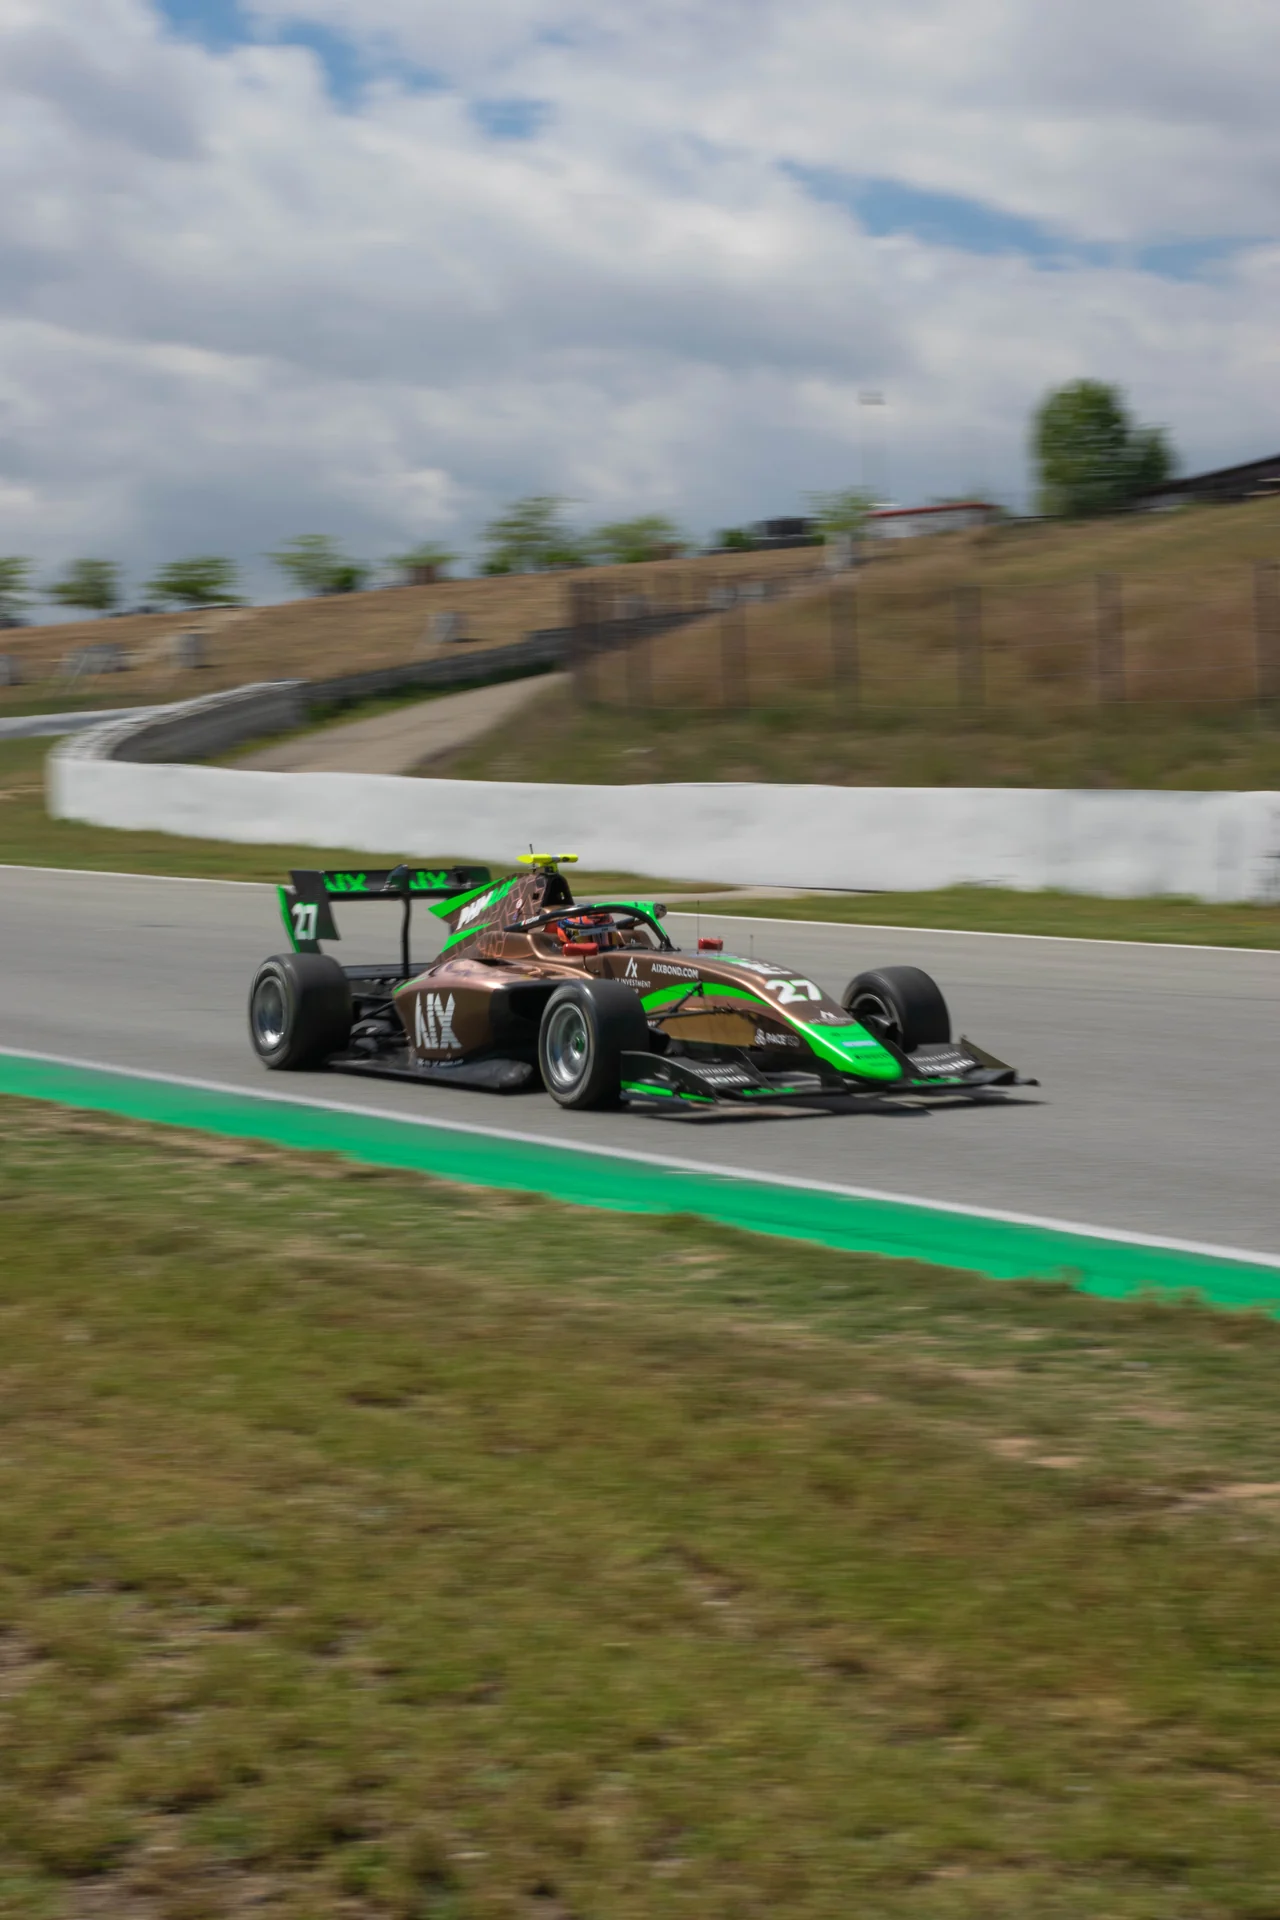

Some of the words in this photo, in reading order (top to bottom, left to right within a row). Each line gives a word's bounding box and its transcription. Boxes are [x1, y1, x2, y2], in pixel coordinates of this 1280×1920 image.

[291, 903, 318, 940] 27
[652, 963, 699, 979] AIXBOND.COM
[765, 979, 822, 1005] 27
